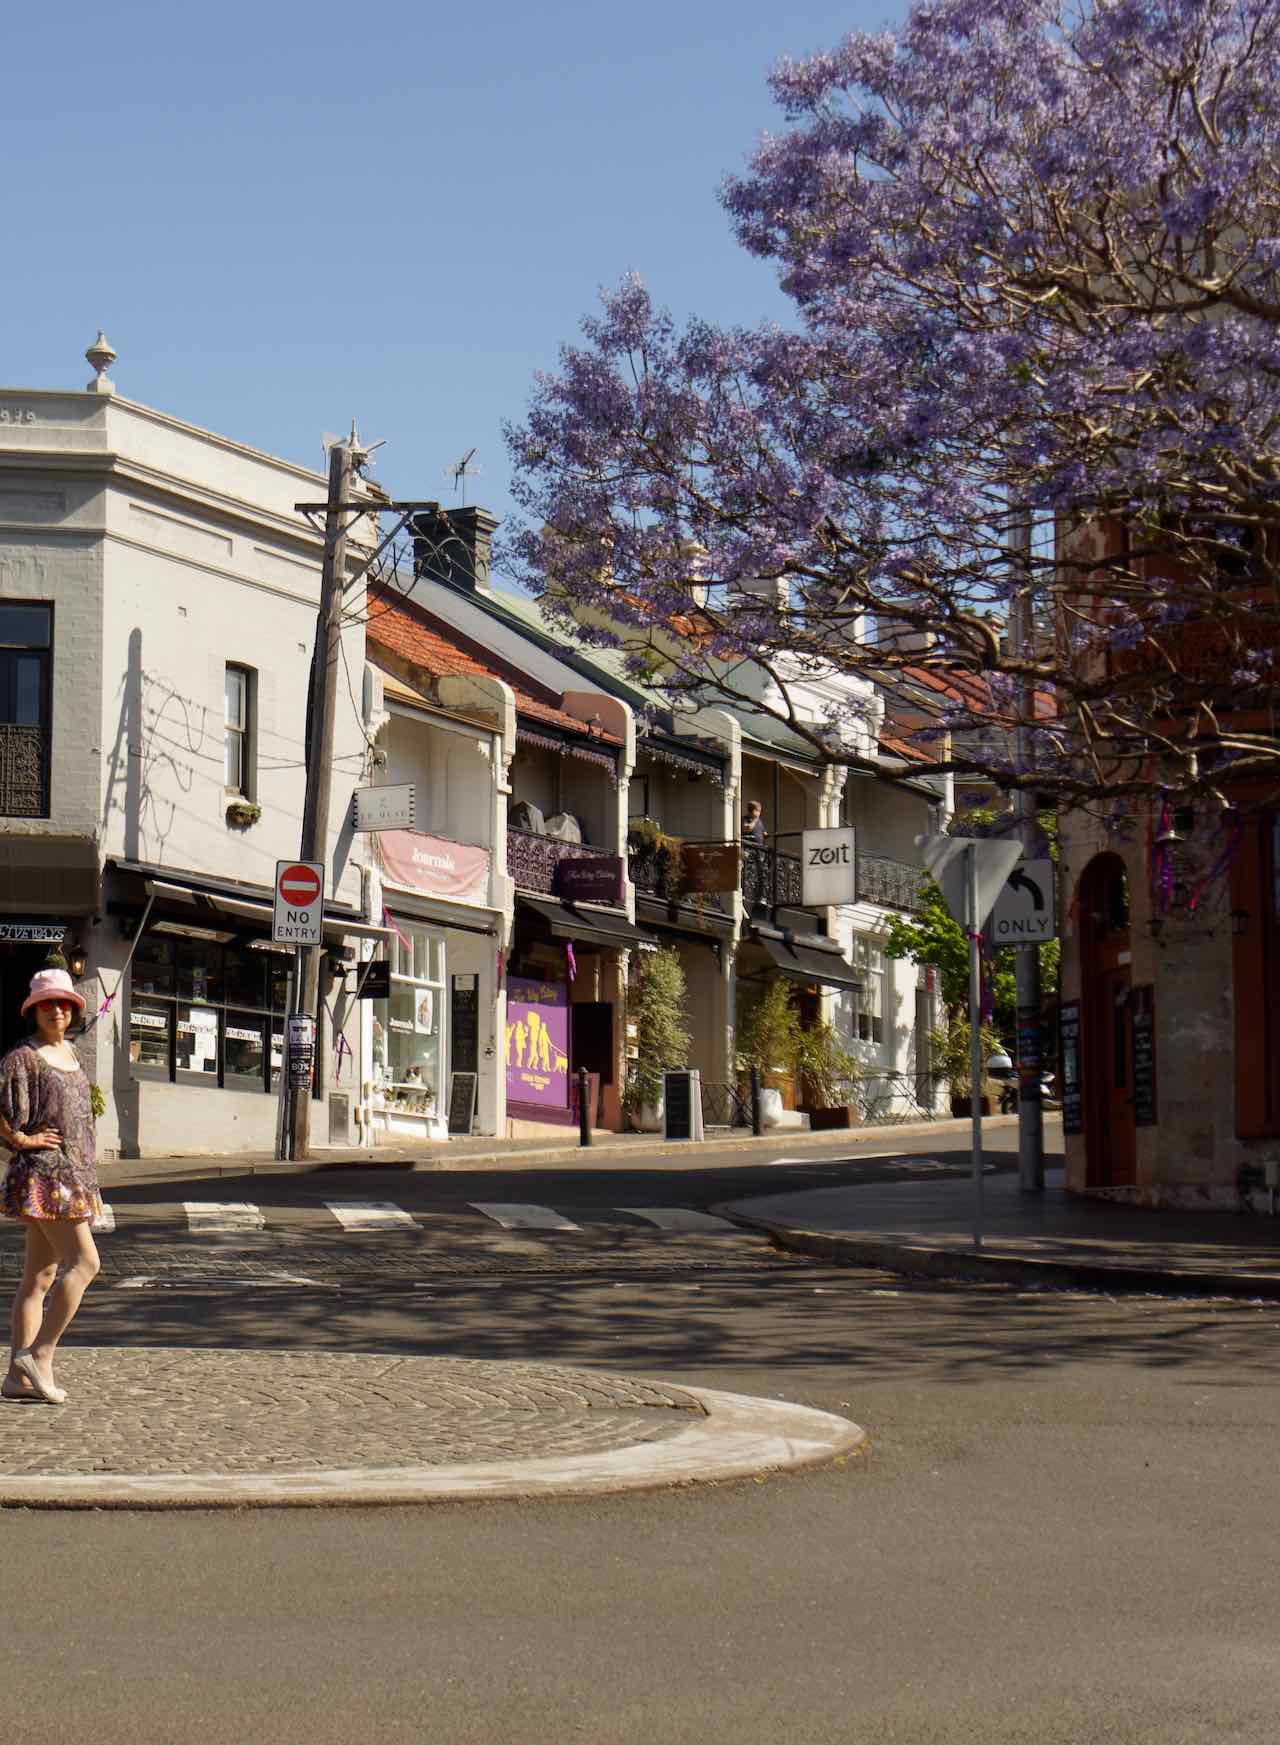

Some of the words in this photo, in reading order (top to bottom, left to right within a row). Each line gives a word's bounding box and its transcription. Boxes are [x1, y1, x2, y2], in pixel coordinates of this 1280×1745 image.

[287, 911, 310, 924] NO
[277, 926, 317, 938] ENTRY
[999, 918, 1049, 934] ONLY
